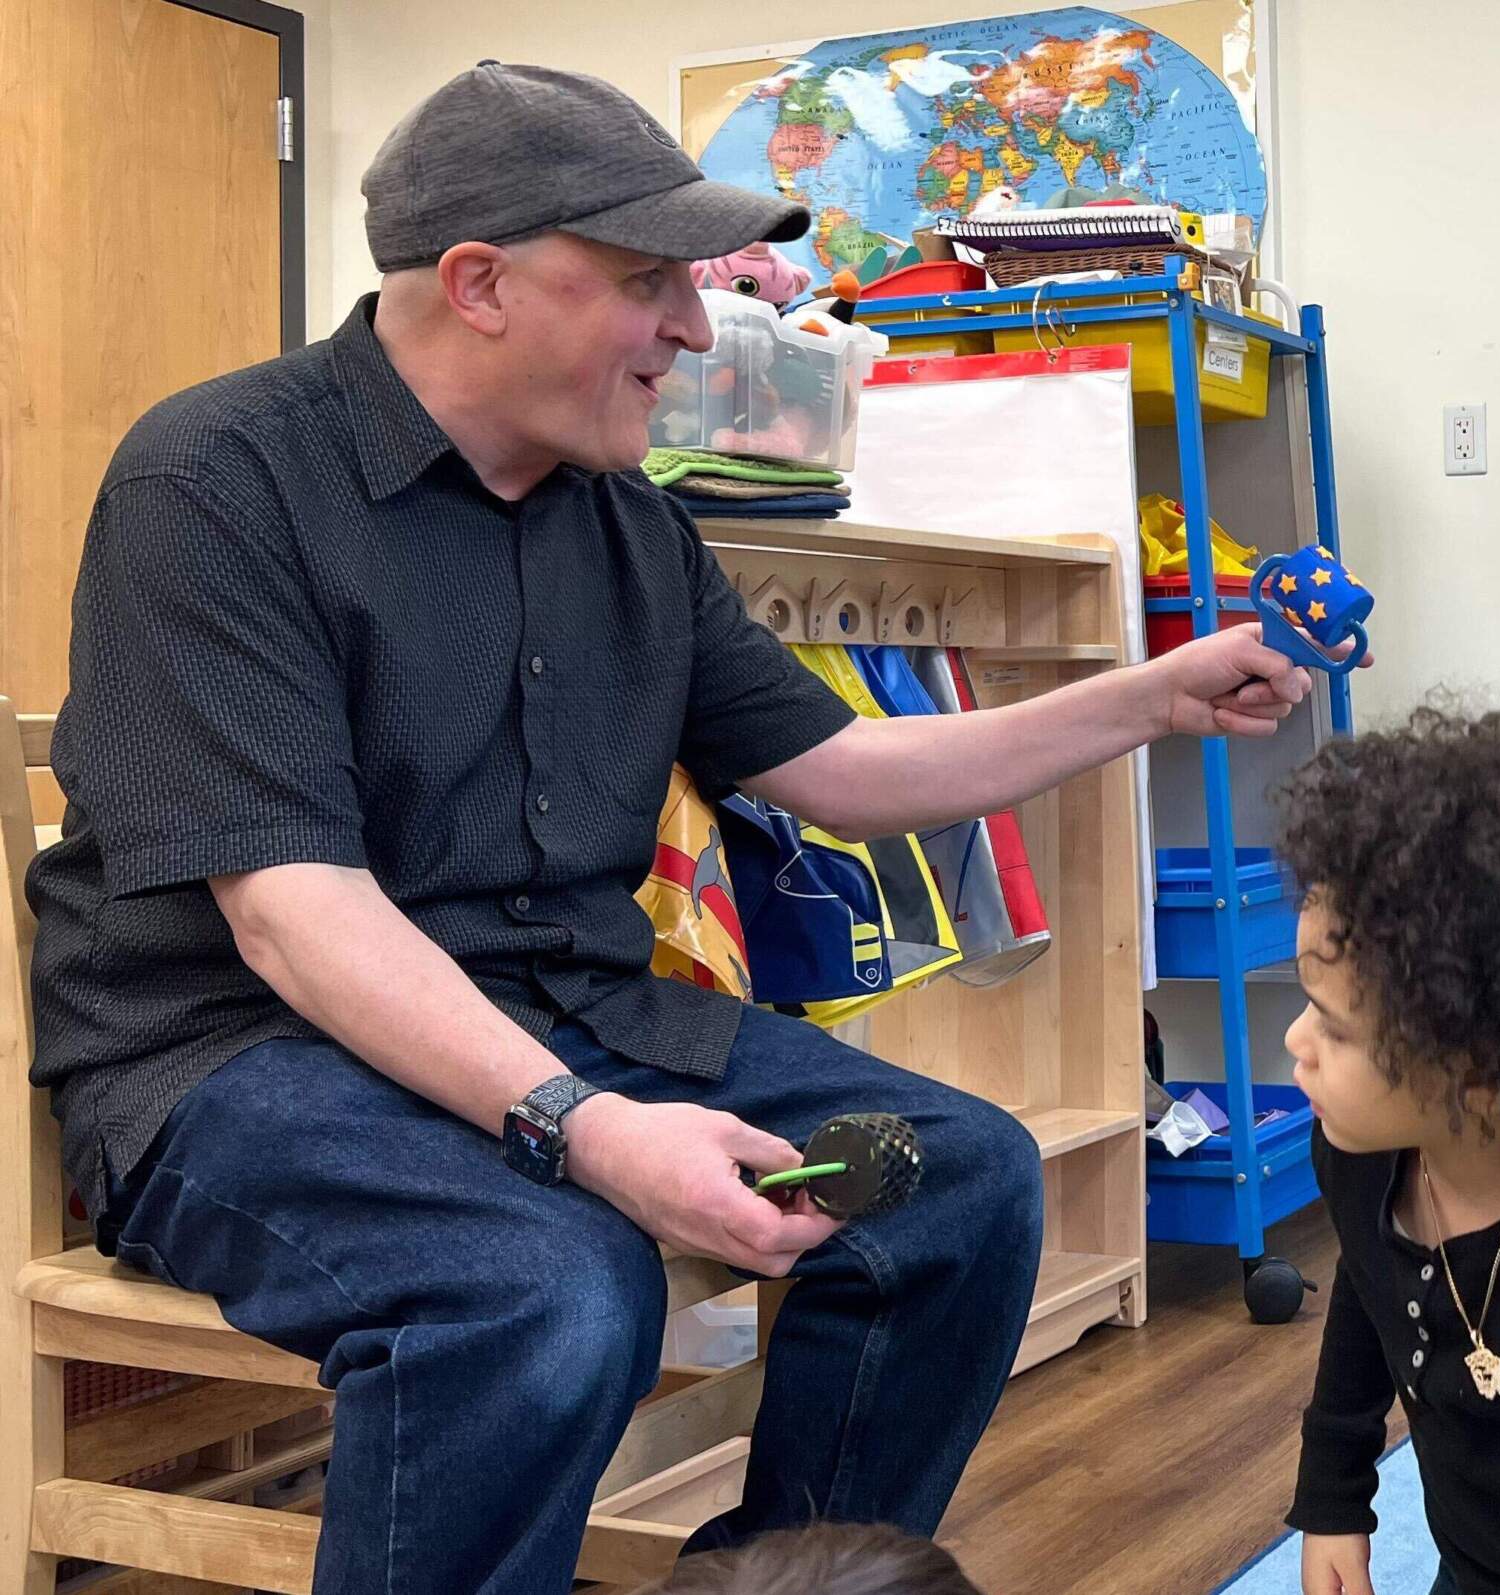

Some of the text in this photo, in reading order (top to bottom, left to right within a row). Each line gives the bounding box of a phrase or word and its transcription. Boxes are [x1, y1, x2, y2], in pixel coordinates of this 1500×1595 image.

[923, 22, 1019, 42] ARCTIC OCEAN
[1171, 101, 1221, 120] PACIFIC
[1185, 147, 1226, 161] OCEAN
[1208, 350, 1239, 372] Centers
